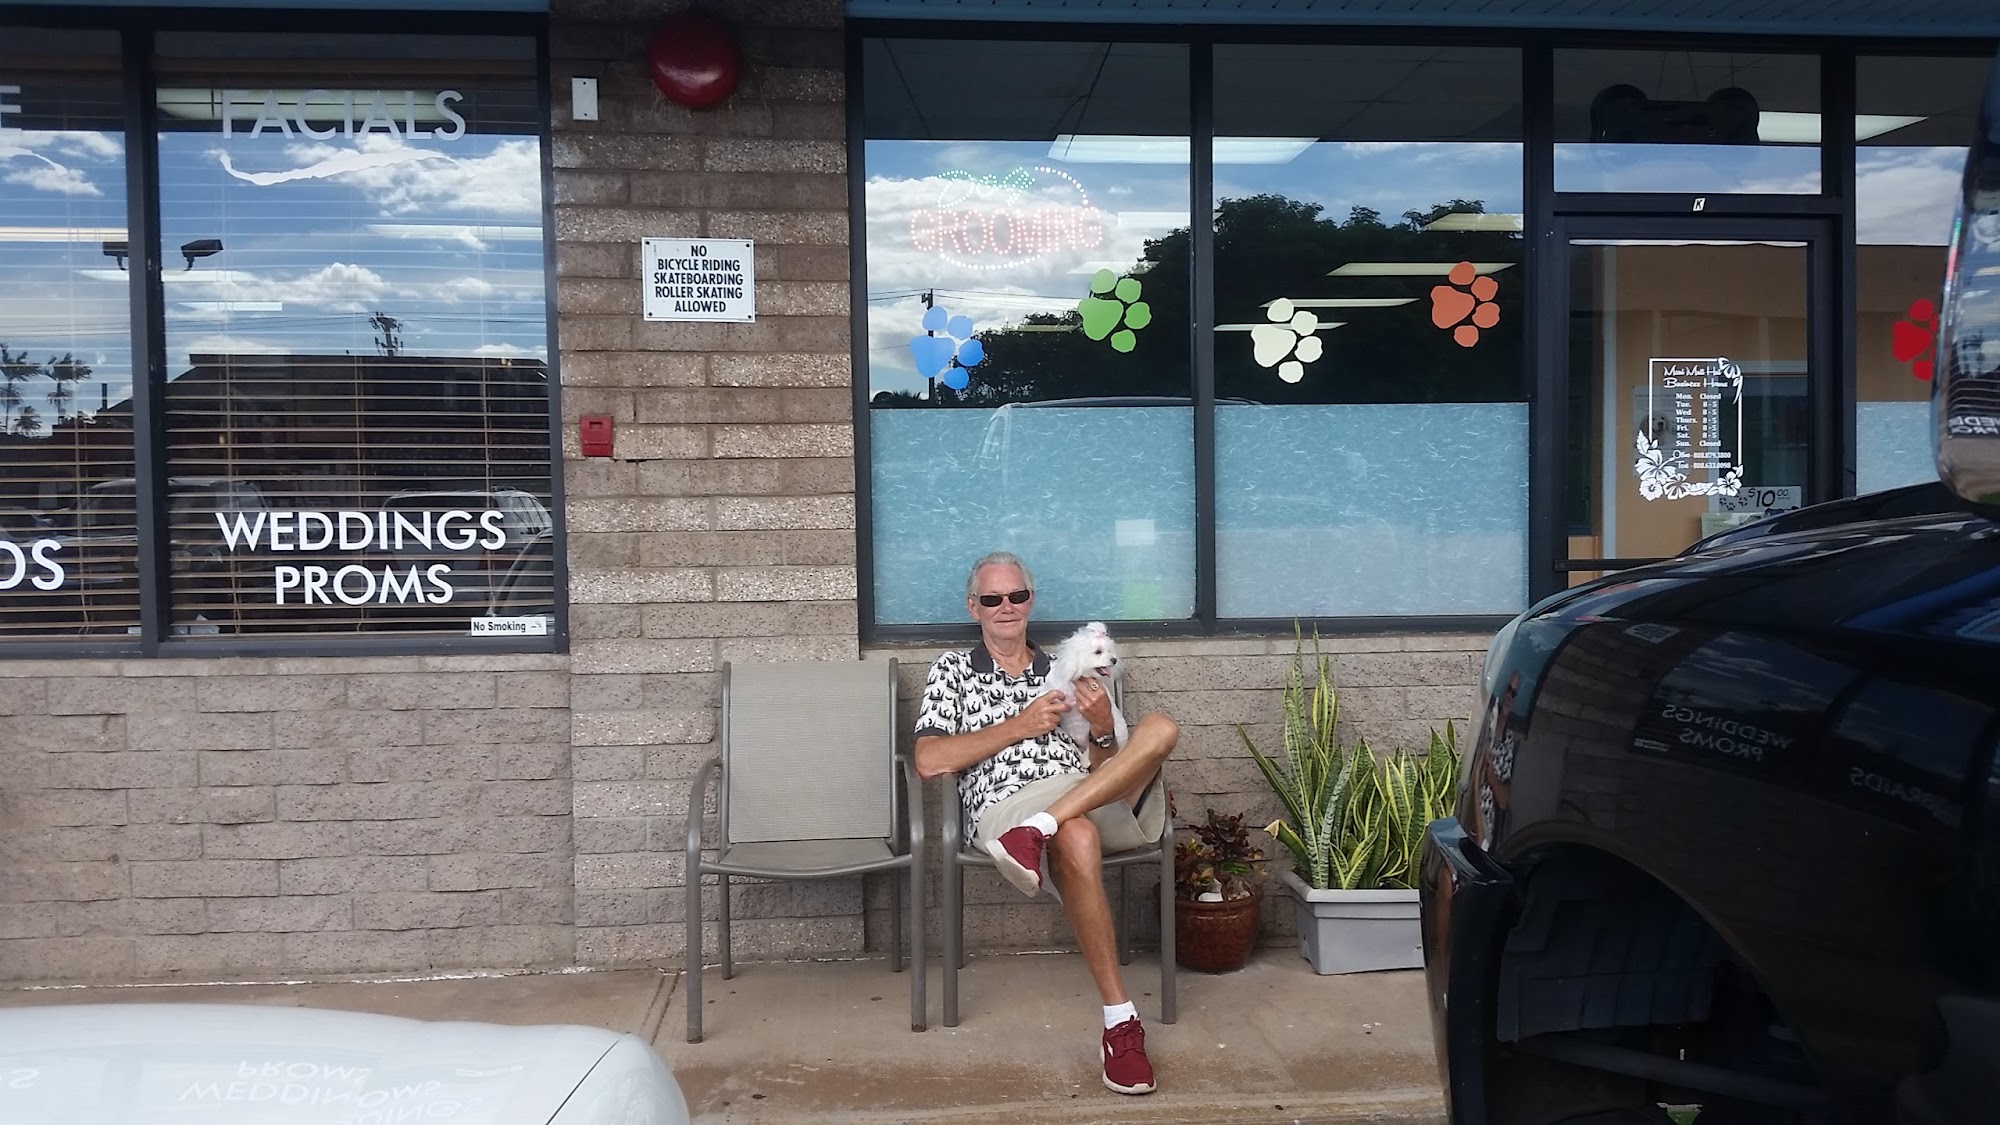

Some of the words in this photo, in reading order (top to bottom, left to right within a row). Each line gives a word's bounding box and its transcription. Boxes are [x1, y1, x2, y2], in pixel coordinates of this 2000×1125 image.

[222, 90, 466, 141] FACIALS
[937, 166, 1035, 207] Dog
[911, 206, 1102, 255] GROOMING
[691, 245, 707, 257] NO
[658, 258, 699, 271] BICYCLE
[702, 259, 740, 272] RIDING
[653, 272, 743, 286] SKATEBOARDING
[655, 286, 694, 298] ROLLER
[696, 287, 743, 299] SKATING
[674, 300, 726, 313] ALLOWED
[1663, 377, 1700, 388] Business
[1703, 377, 1728, 387] Hours
[215, 510, 506, 552] WEDDINGS
[275, 564, 454, 605] PROMS
[473, 622, 485, 631] No
[487, 621, 526, 633] Smoking
